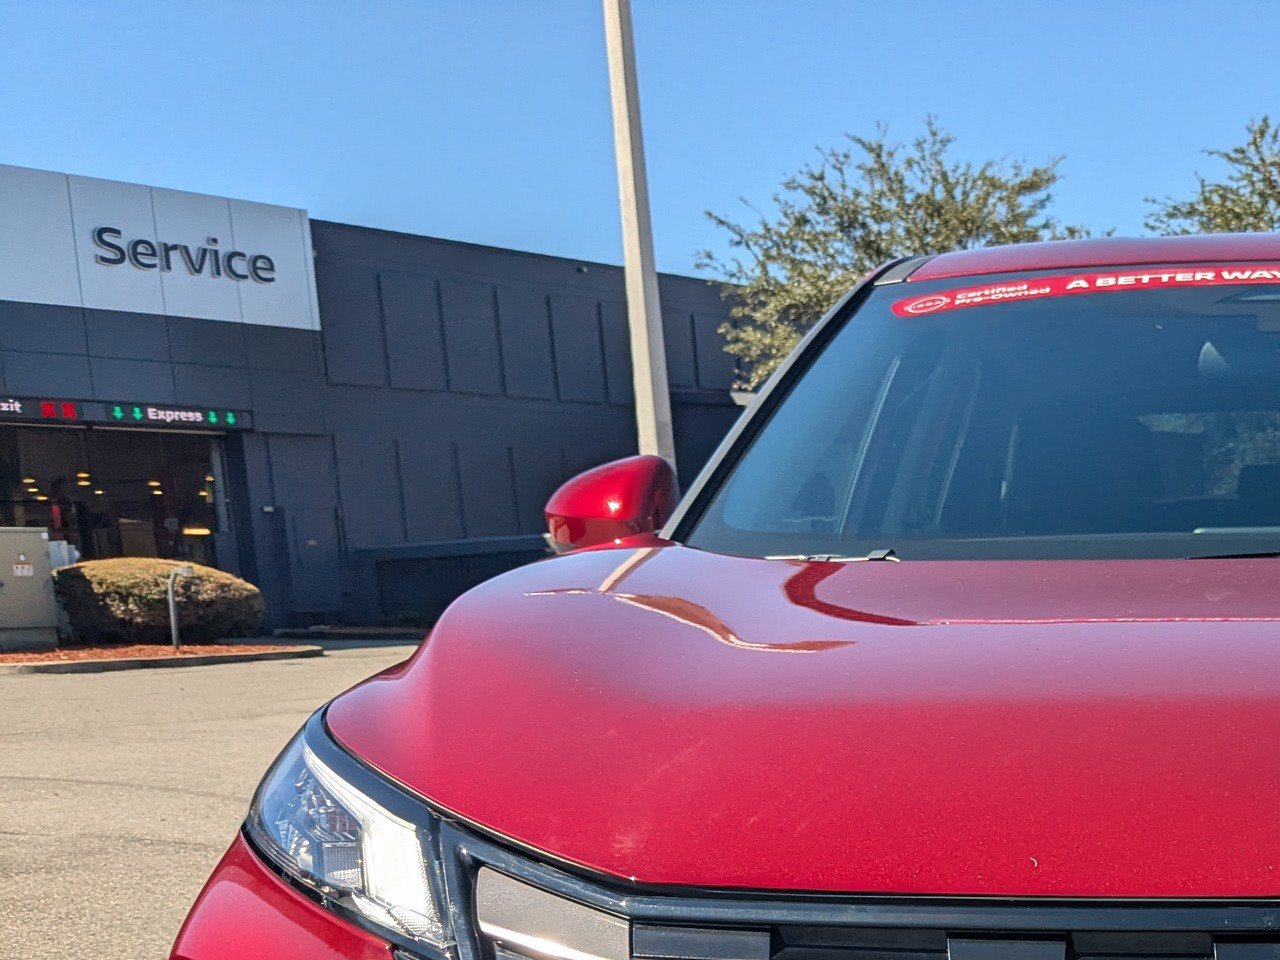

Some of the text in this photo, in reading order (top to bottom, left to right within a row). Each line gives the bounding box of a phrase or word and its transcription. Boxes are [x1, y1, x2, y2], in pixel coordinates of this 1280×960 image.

[93, 226, 276, 283] Service
[1065, 279, 1090, 290] A
[1095, 271, 1216, 287] BETTER
[954, 287, 1051, 305] Pre-Owned
[955, 283, 1029, 299] Certified
[0, 399, 22, 413] xit
[147, 407, 204, 423] Express
